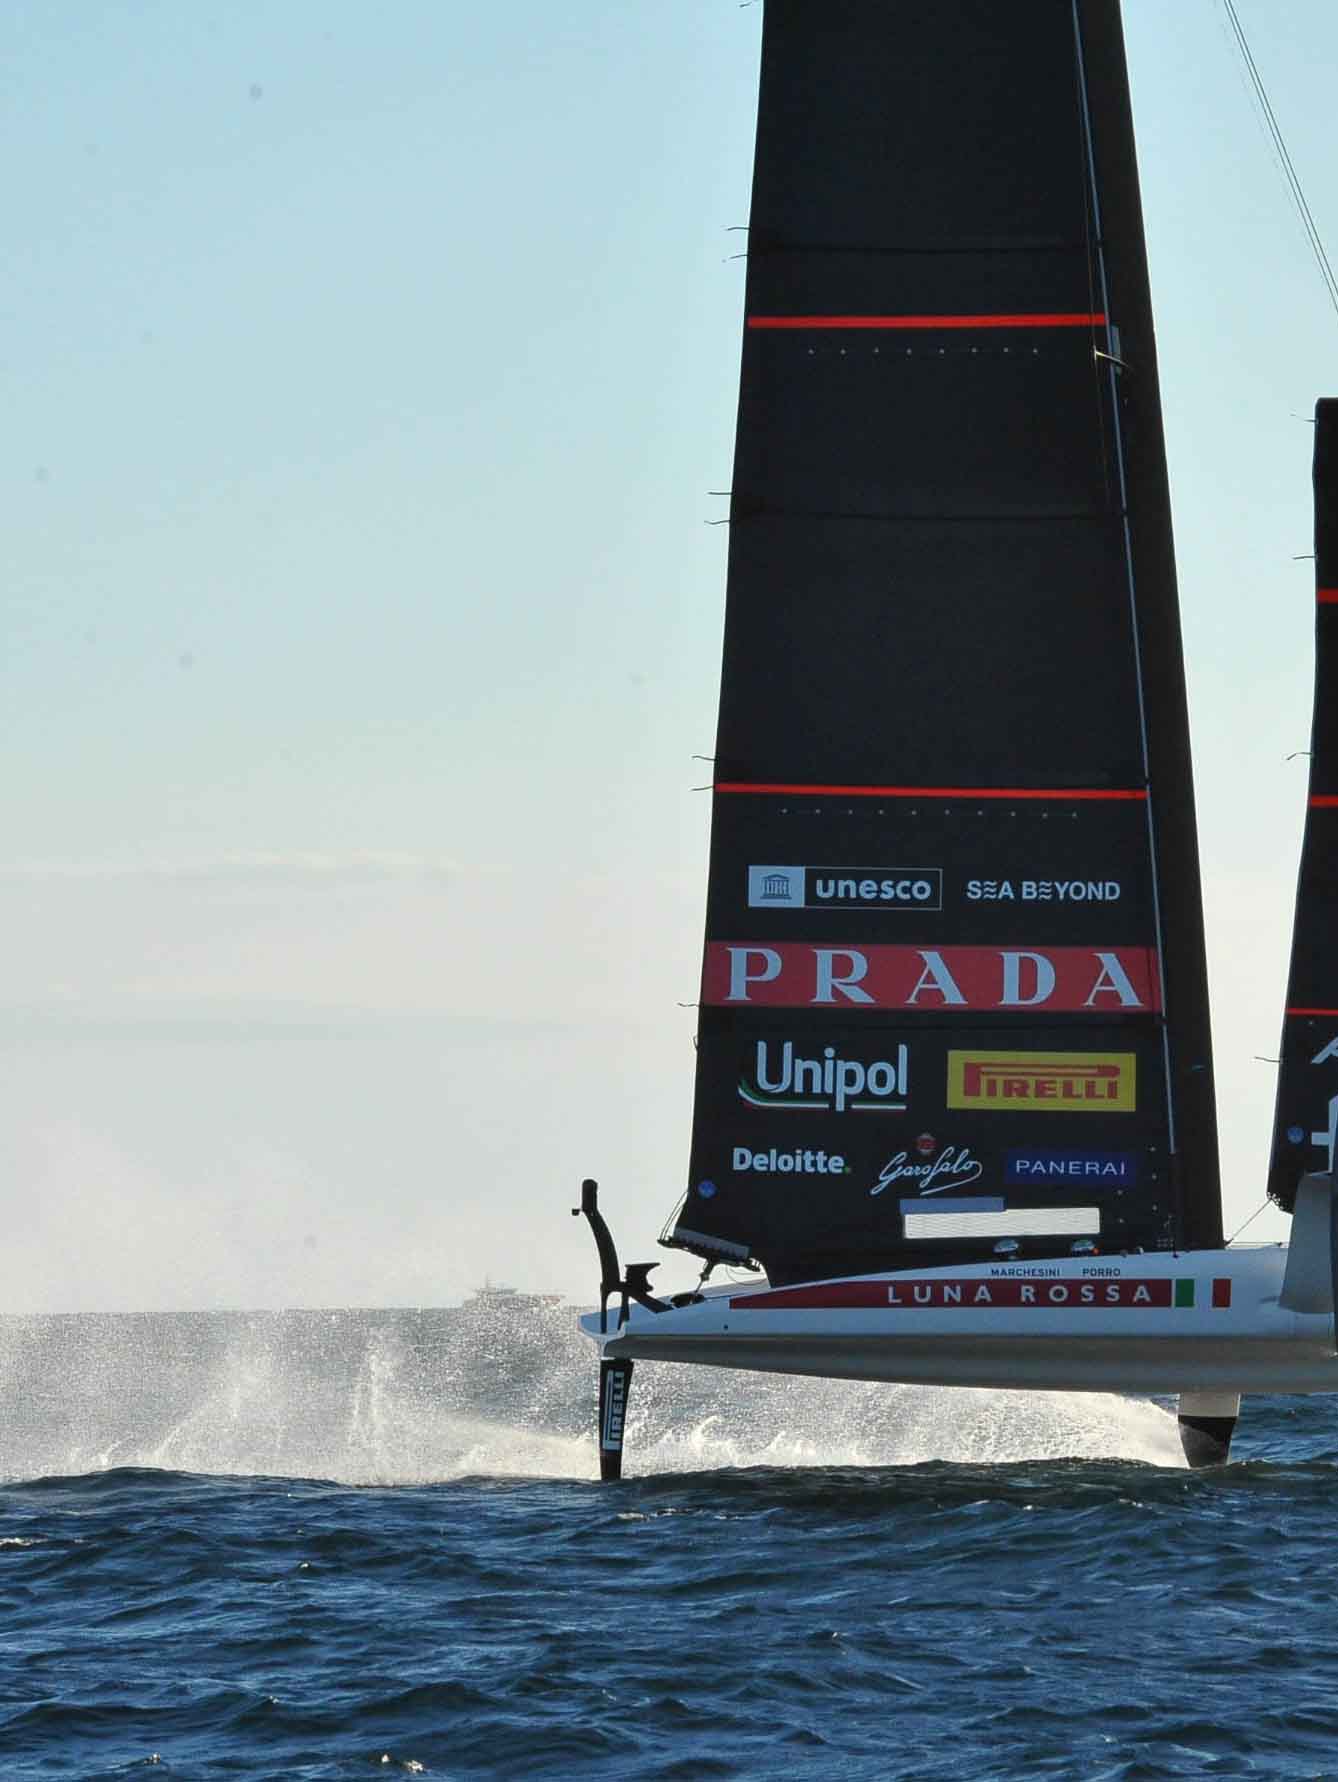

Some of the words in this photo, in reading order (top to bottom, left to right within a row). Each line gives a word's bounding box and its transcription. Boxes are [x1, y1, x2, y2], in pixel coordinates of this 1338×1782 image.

[816, 876, 931, 901] unesco
[966, 880, 1015, 900] SEA
[1022, 881, 1121, 901] BEYOND
[724, 946, 1144, 1007] PRADA
[757, 1041, 907, 1111] Unipol
[964, 1062, 1120, 1099] PIRELLI
[870, 1147, 982, 1195] Garofalo
[1016, 1159, 1126, 1176] PANERAI
[991, 1268, 1060, 1277] MARCHESINI
[1082, 1268, 1121, 1277] PORRO
[888, 1285, 992, 1303] LUNA
[1021, 1285, 1151, 1303] ROSSA
